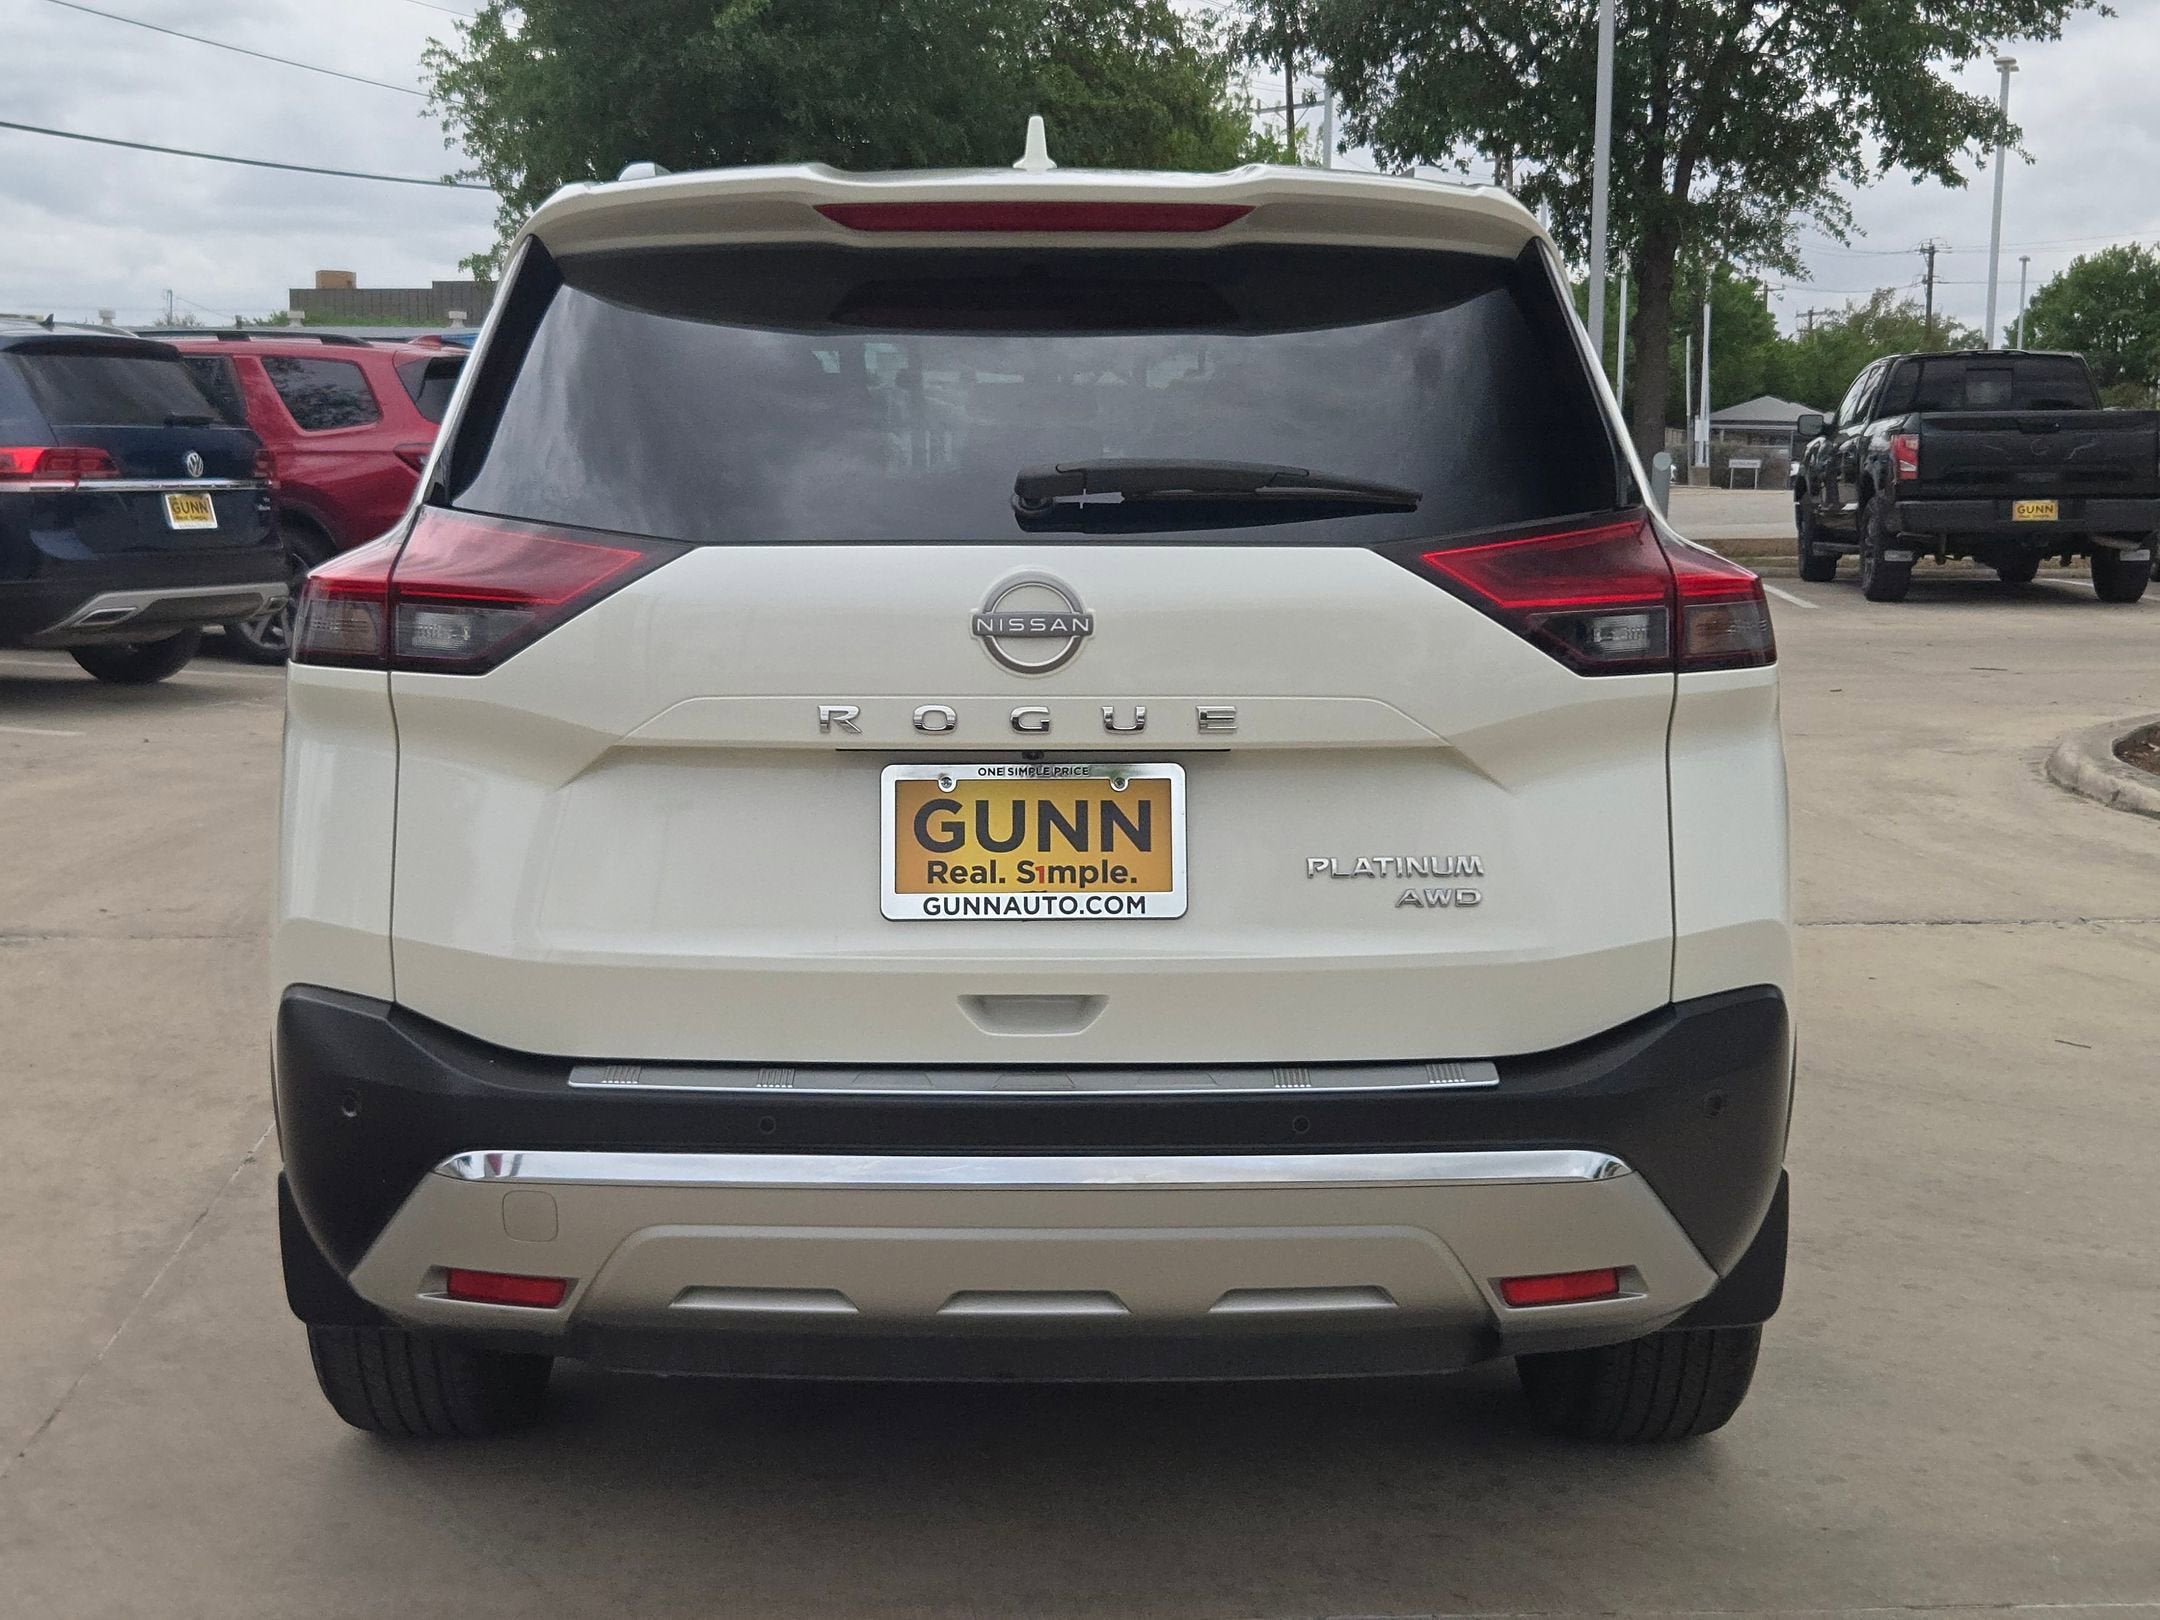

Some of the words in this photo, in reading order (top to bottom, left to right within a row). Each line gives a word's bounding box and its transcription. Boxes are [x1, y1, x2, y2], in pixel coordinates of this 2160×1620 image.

[171, 500, 209, 514] GUNN
[2017, 504, 2054, 514] GUNN
[976, 617, 1092, 632] NISSAN
[817, 704, 1238, 734] ROGUE
[977, 767, 1004, 777] ONE
[1007, 767, 1050, 777] SIMPLE
[1054, 766, 1090, 776] PRICE
[913, 798, 1152, 853] GUNN
[927, 861, 1006, 884] Real.
[1306, 855, 1484, 879] PLATINUM
[923, 896, 1146, 916] GUNNAUTO.COM
[1395, 888, 1483, 908] AWD
